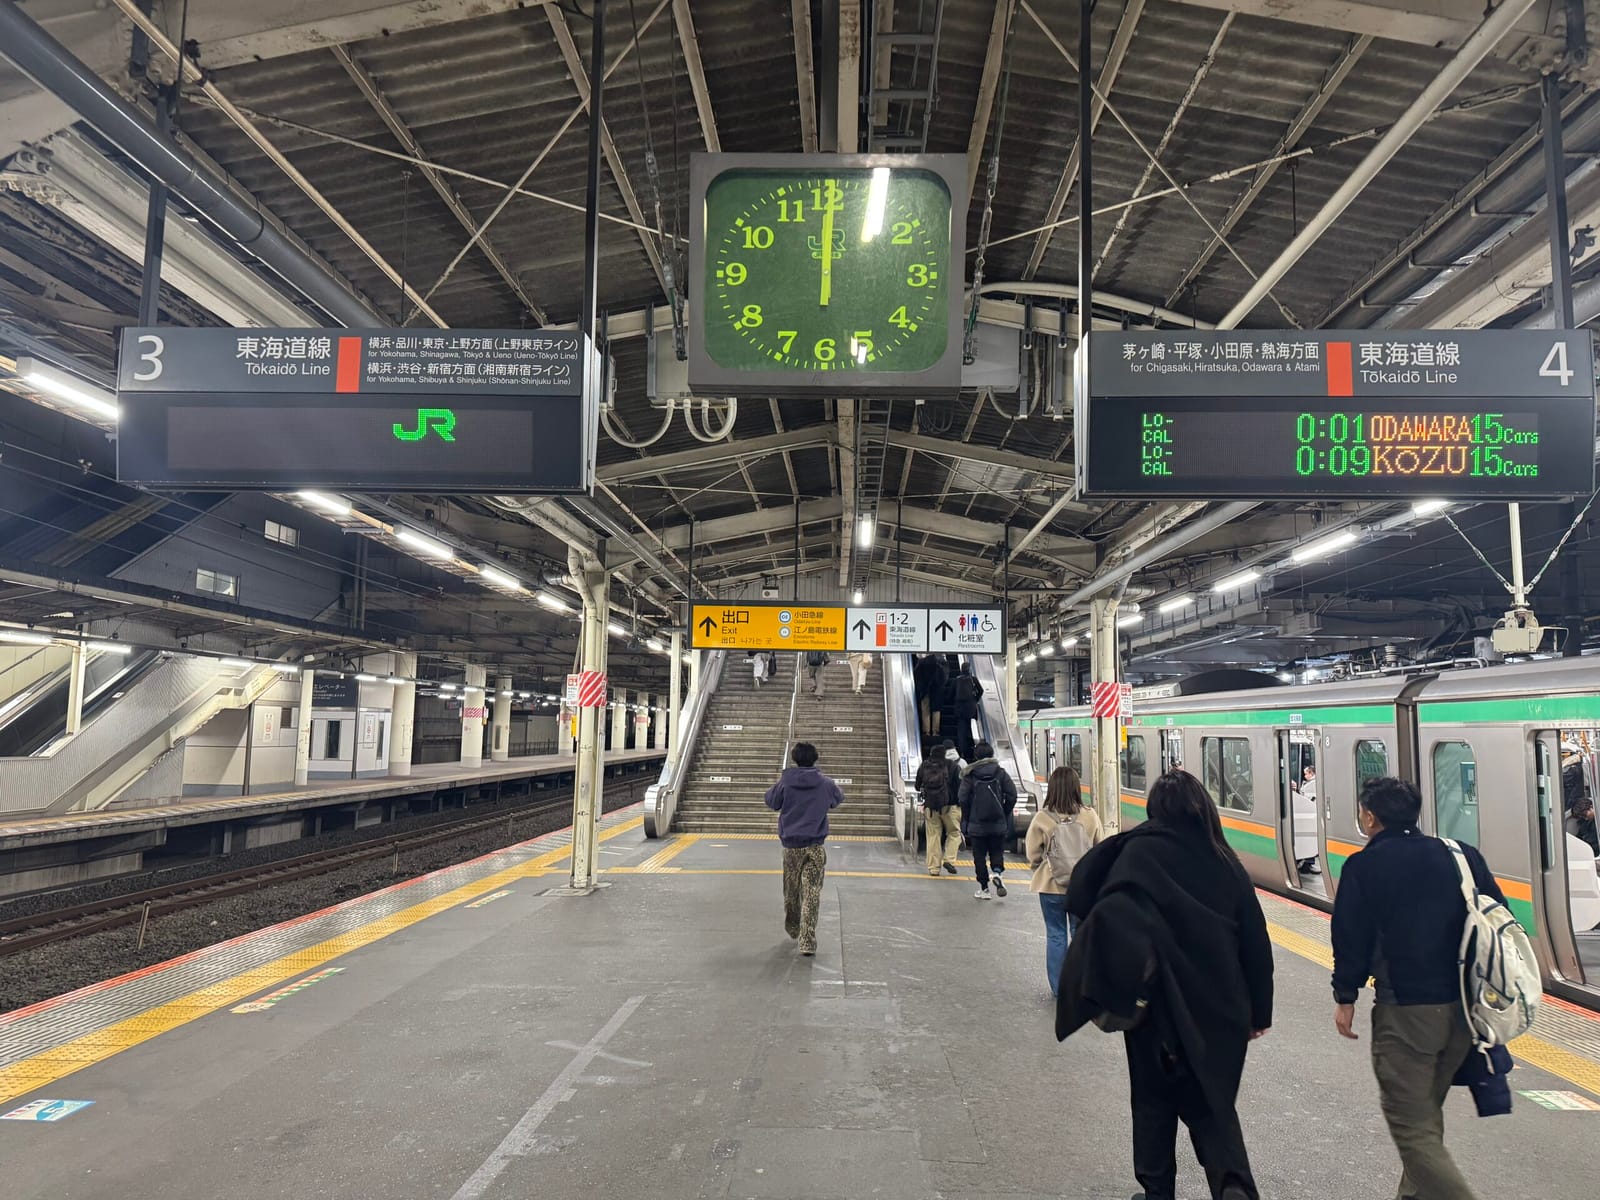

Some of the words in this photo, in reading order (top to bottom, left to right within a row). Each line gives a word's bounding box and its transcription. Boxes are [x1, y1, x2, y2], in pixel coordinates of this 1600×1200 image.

[811, 188, 844, 210] 12
[777, 200, 805, 222] 11
[742, 226, 774, 248] 10
[808, 229, 846, 251] JR
[891, 222, 913, 244] 2
[725, 263, 747, 285] 9
[907, 264, 928, 287] 3
[741, 305, 763, 327] 8
[888, 306, 910, 328] 4
[236, 336, 331, 360] 東海道線
[777, 331, 797, 353] 7
[814, 338, 836, 361] 6
[853, 330, 873, 353] 5
[133, 335, 164, 381] 3
[420, 351, 461, 359] Shinagawa,
[1359, 341, 1460, 366] 東海道線
[1538, 341, 1574, 386] 4
[245, 362, 297, 375] Tōkaidō
[302, 362, 331, 375] Line
[1130, 362, 1143, 373] for
[1146, 362, 1194, 374] Chigasaki,
[1195, 362, 1240, 373] Hiratsuka,
[1242, 362, 1282, 373] Odawara
[1285, 363, 1292, 372] &
[1295, 362, 1320, 372] Atami
[1360, 370, 1420, 383] Tōkaidō
[1425, 370, 1457, 383] Line
[419, 376, 447, 384] Shibuya
[456, 377, 486, 385] Shinjuku
[393, 408, 456, 441] JR
[1143, 413, 1173, 427] LO-
[1296, 413, 1366, 443] 0:01
[1370, 415, 1472, 442] ODAWARA
[1143, 429, 1173, 443] CAL
[1142, 445, 1173, 459] LO-
[1296, 445, 1370, 475] 0:09
[1142, 461, 1172, 475] CAL
[722, 610, 749, 624] 出口
[721, 627, 737, 635] Exit
